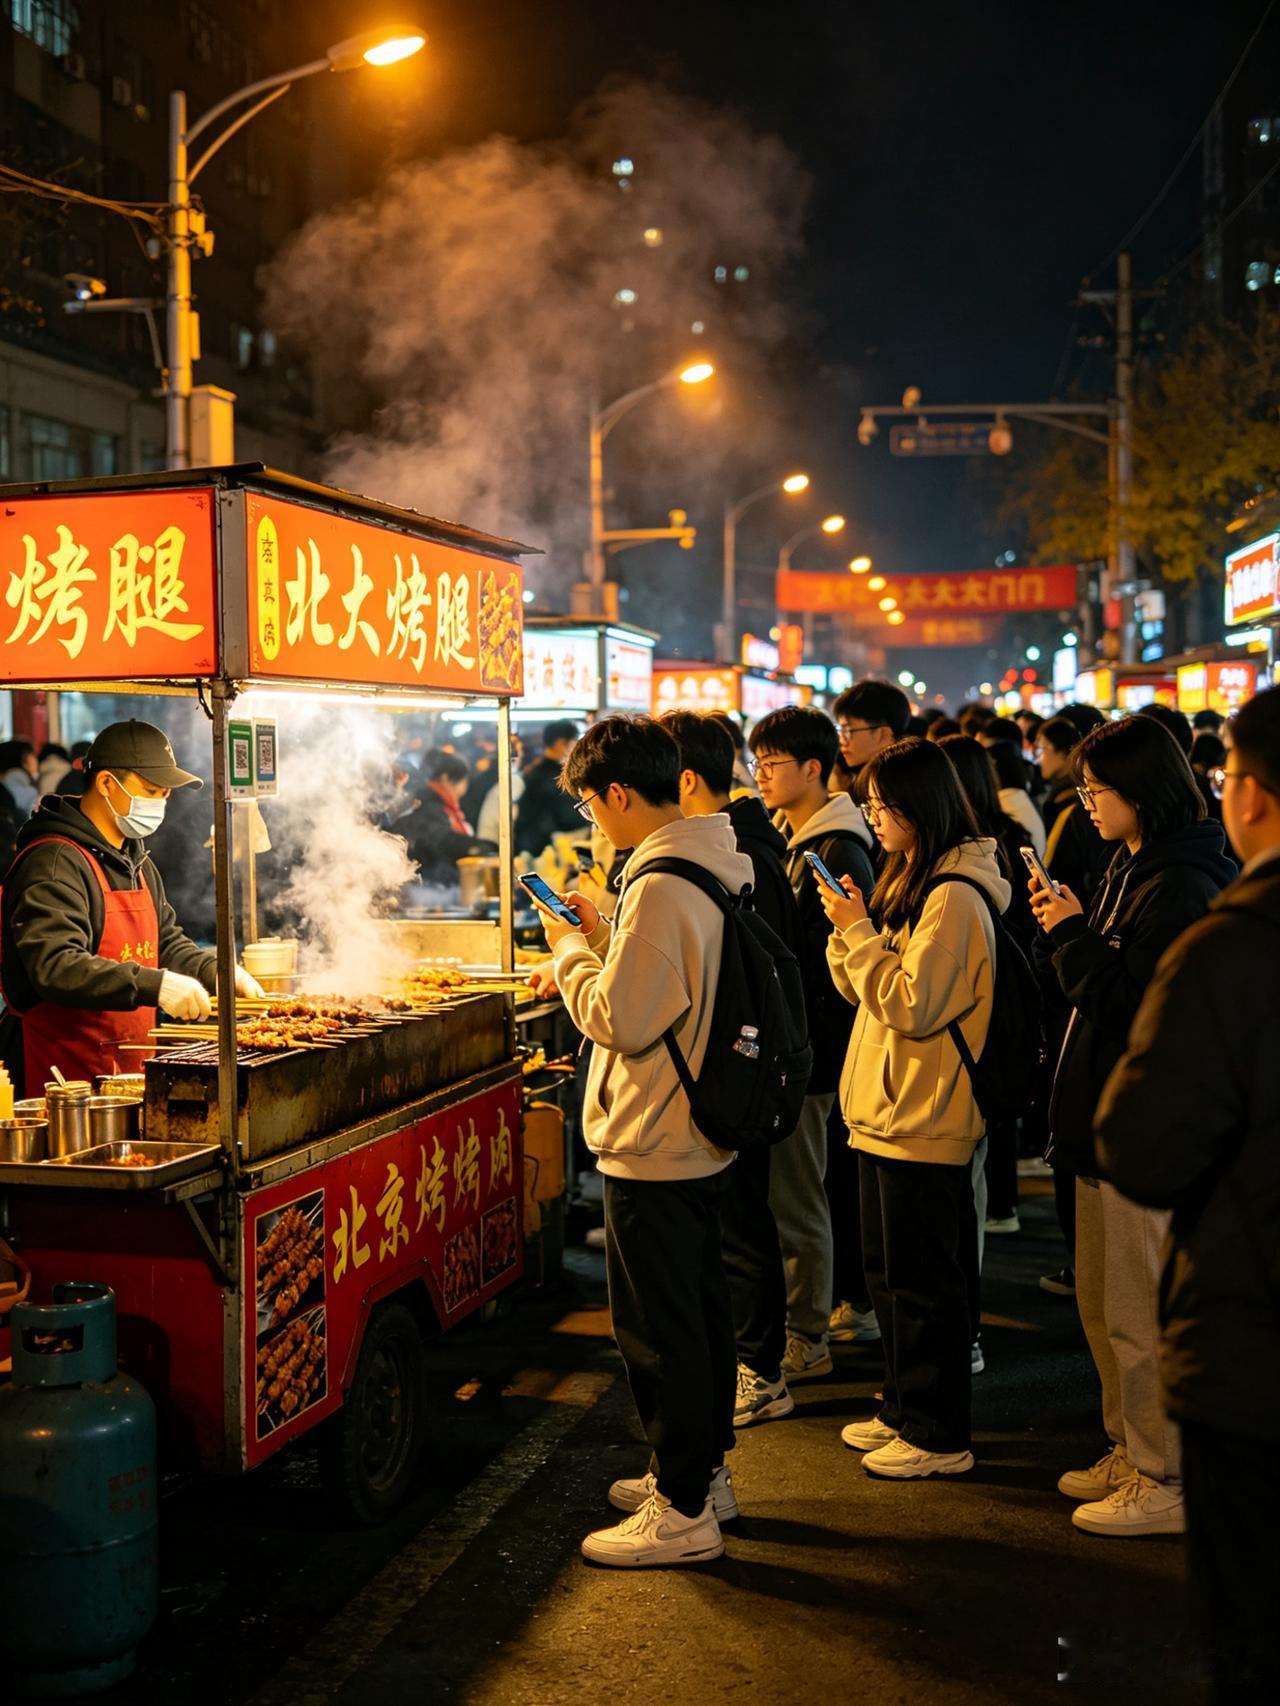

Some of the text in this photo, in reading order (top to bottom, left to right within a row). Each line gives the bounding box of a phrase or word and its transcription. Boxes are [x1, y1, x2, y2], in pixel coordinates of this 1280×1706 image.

[5, 524, 205, 660] 烤腿
[285, 537, 476, 674] 北大烤腿
